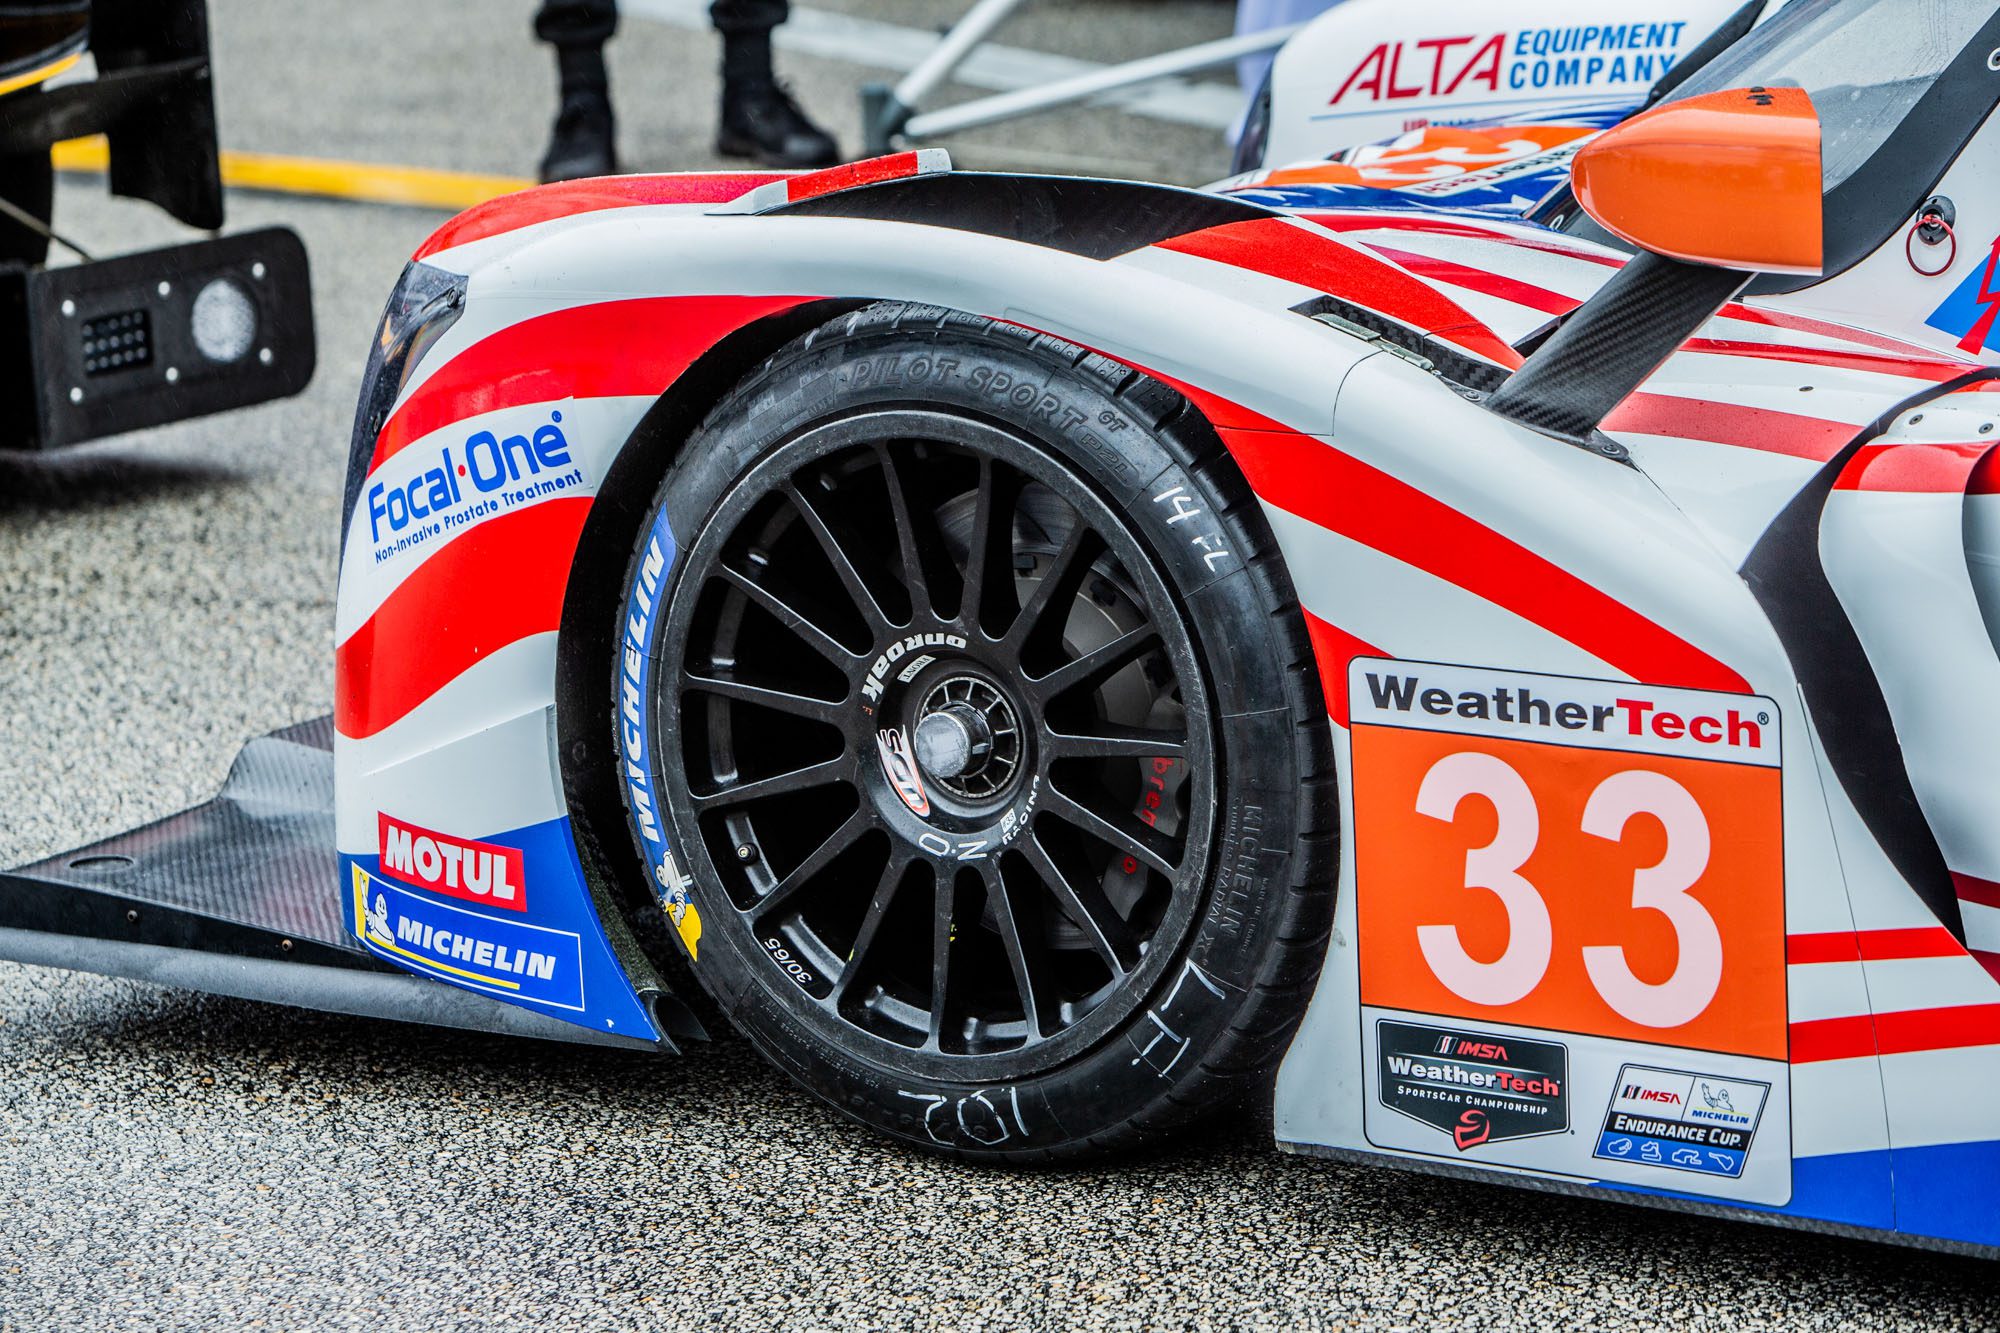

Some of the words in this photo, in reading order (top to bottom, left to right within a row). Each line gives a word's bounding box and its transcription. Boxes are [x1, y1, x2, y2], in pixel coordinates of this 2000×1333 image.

[1329, 33, 1508, 106] ALTA
[1514, 21, 1688, 57] EQUIPMENT
[1509, 53, 1679, 89] COMPANY
[852, 357, 960, 391] PILOT
[966, 365, 1090, 432] SPORT
[375, 522, 441, 564] Non-Invasive
[444, 500, 499, 530] Prostate
[502, 468, 584, 507] Treatment
[620, 534, 666, 844] MICHELIN
[901, 655, 931, 682] FRONT
[384, 824, 516, 901] MOTUL
[1207, 865, 1233, 925] RADIAL
[1219, 804, 1262, 937] MICHELIN
[1414, 751, 1724, 1029] 33
[397, 915, 556, 981] MICHELIN
[764, 936, 814, 985] 30/65
[1457, 1041, 1510, 1062] IMSA
[1640, 1089, 1682, 1106] IMSA
[1692, 1108, 1750, 1125] MICHELIN
